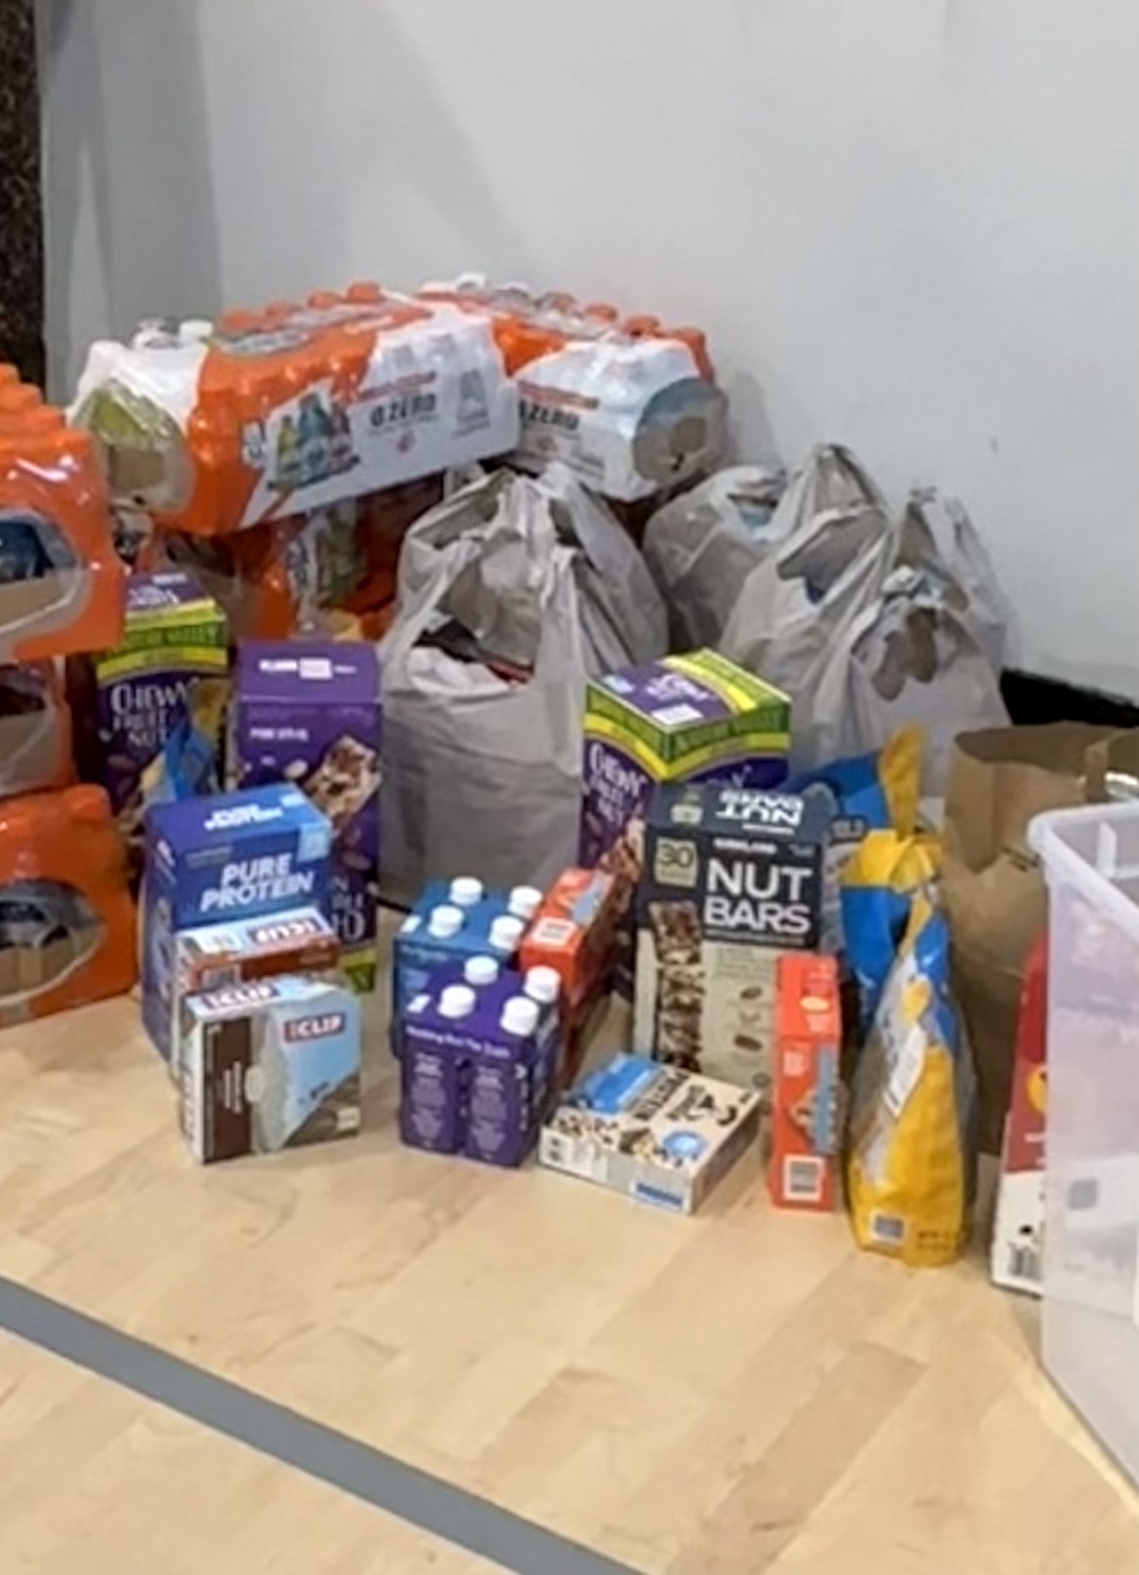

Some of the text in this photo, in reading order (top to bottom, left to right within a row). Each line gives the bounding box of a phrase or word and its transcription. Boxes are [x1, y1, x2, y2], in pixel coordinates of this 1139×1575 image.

[220, 852, 293, 889] PURE
[659, 843, 695, 869] 30
[199, 870, 315, 913] PROTEIN
[706, 857, 813, 901] NUT
[703, 895, 811, 935] BARS
[287, 1015, 343, 1039] CLIF
